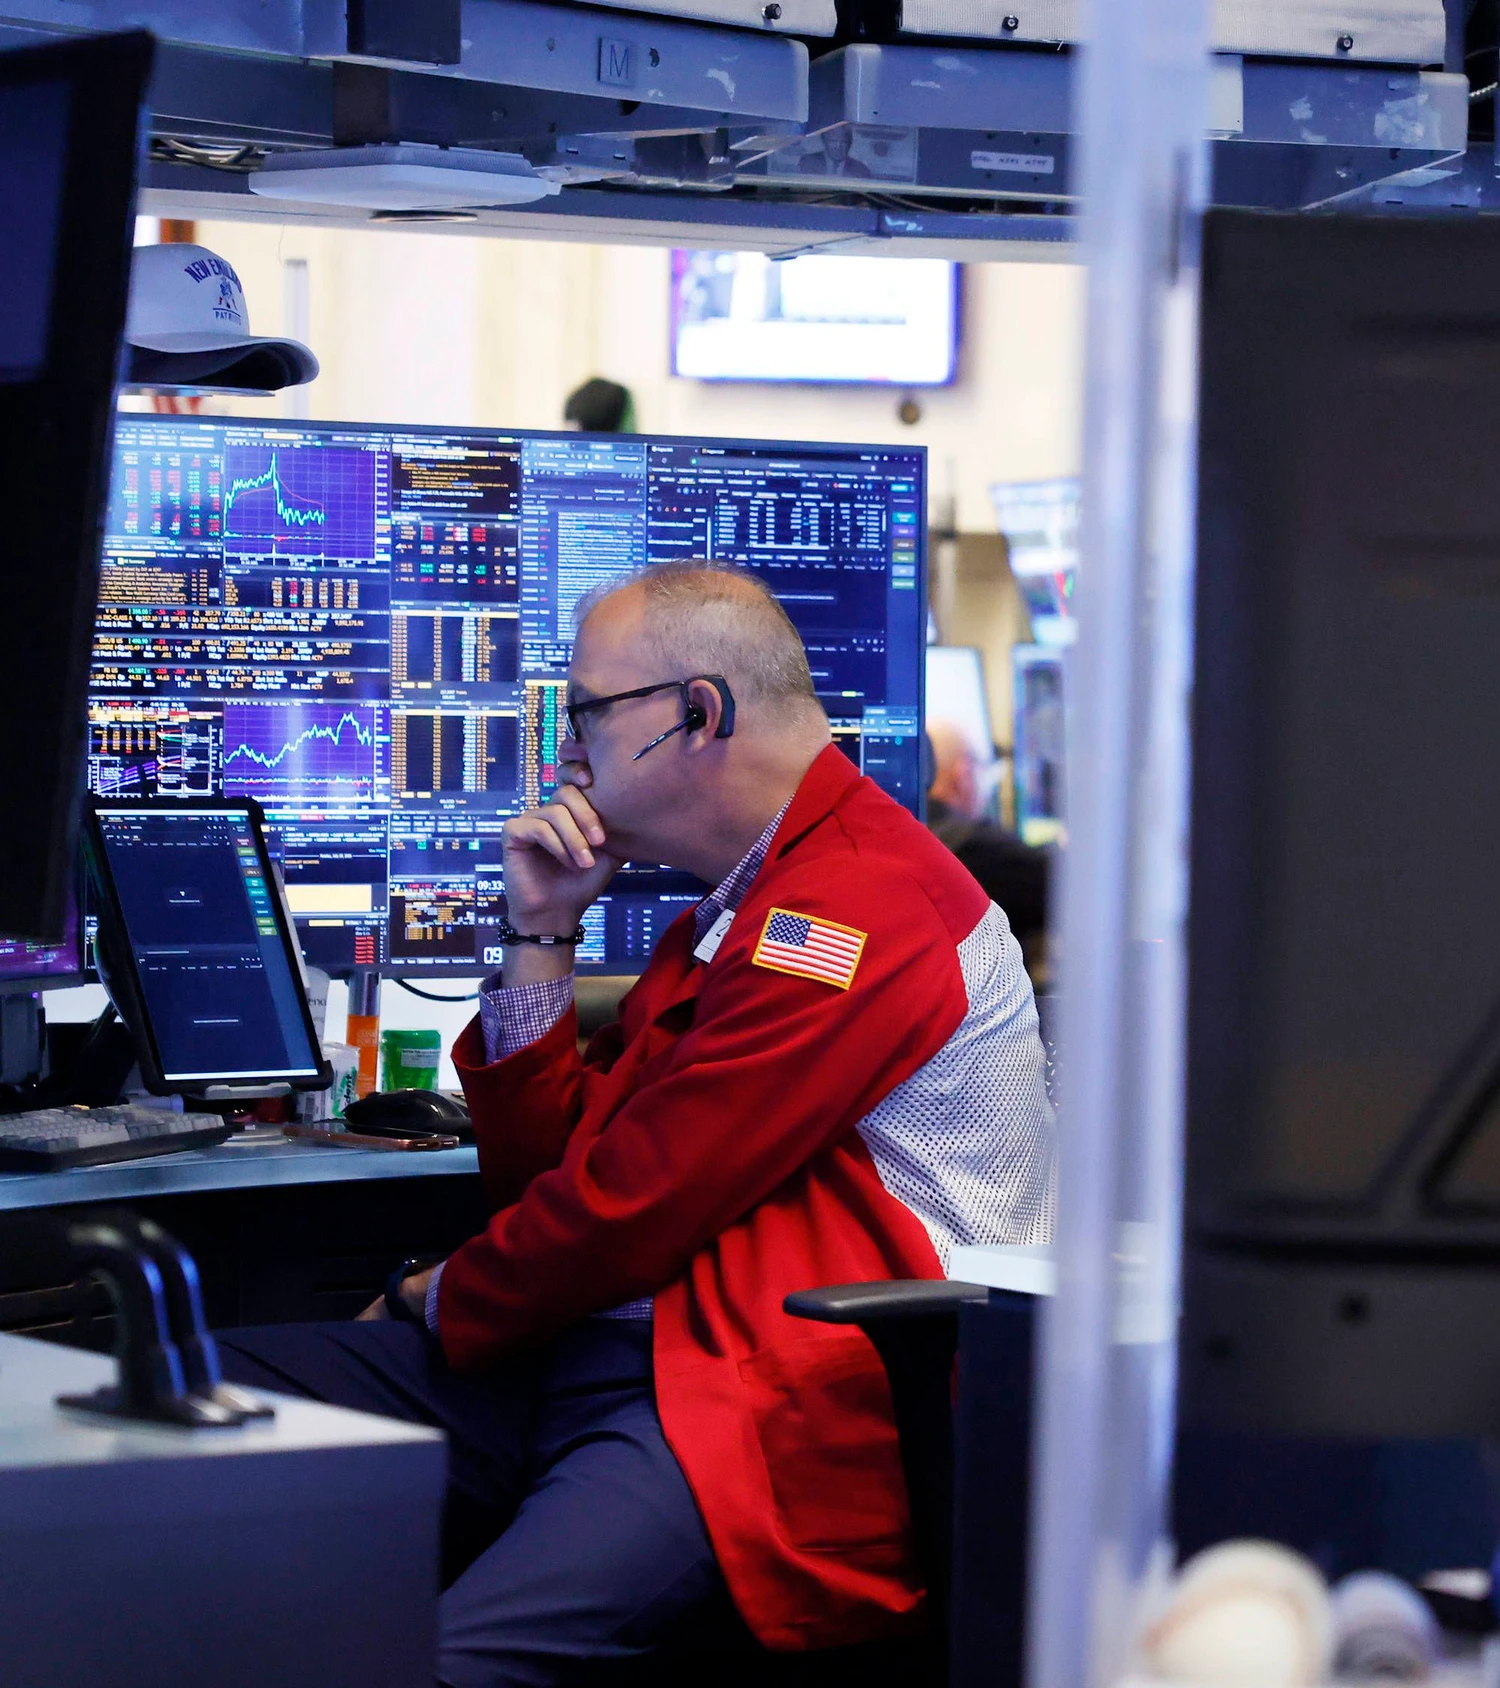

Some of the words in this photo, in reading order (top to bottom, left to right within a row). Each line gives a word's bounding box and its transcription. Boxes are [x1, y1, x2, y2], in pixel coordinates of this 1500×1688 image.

[609, 44, 629, 79] M
[184, 259, 211, 283] NEW
[477, 880, 505, 891] 09:33:
[484, 946, 503, 965] 09
